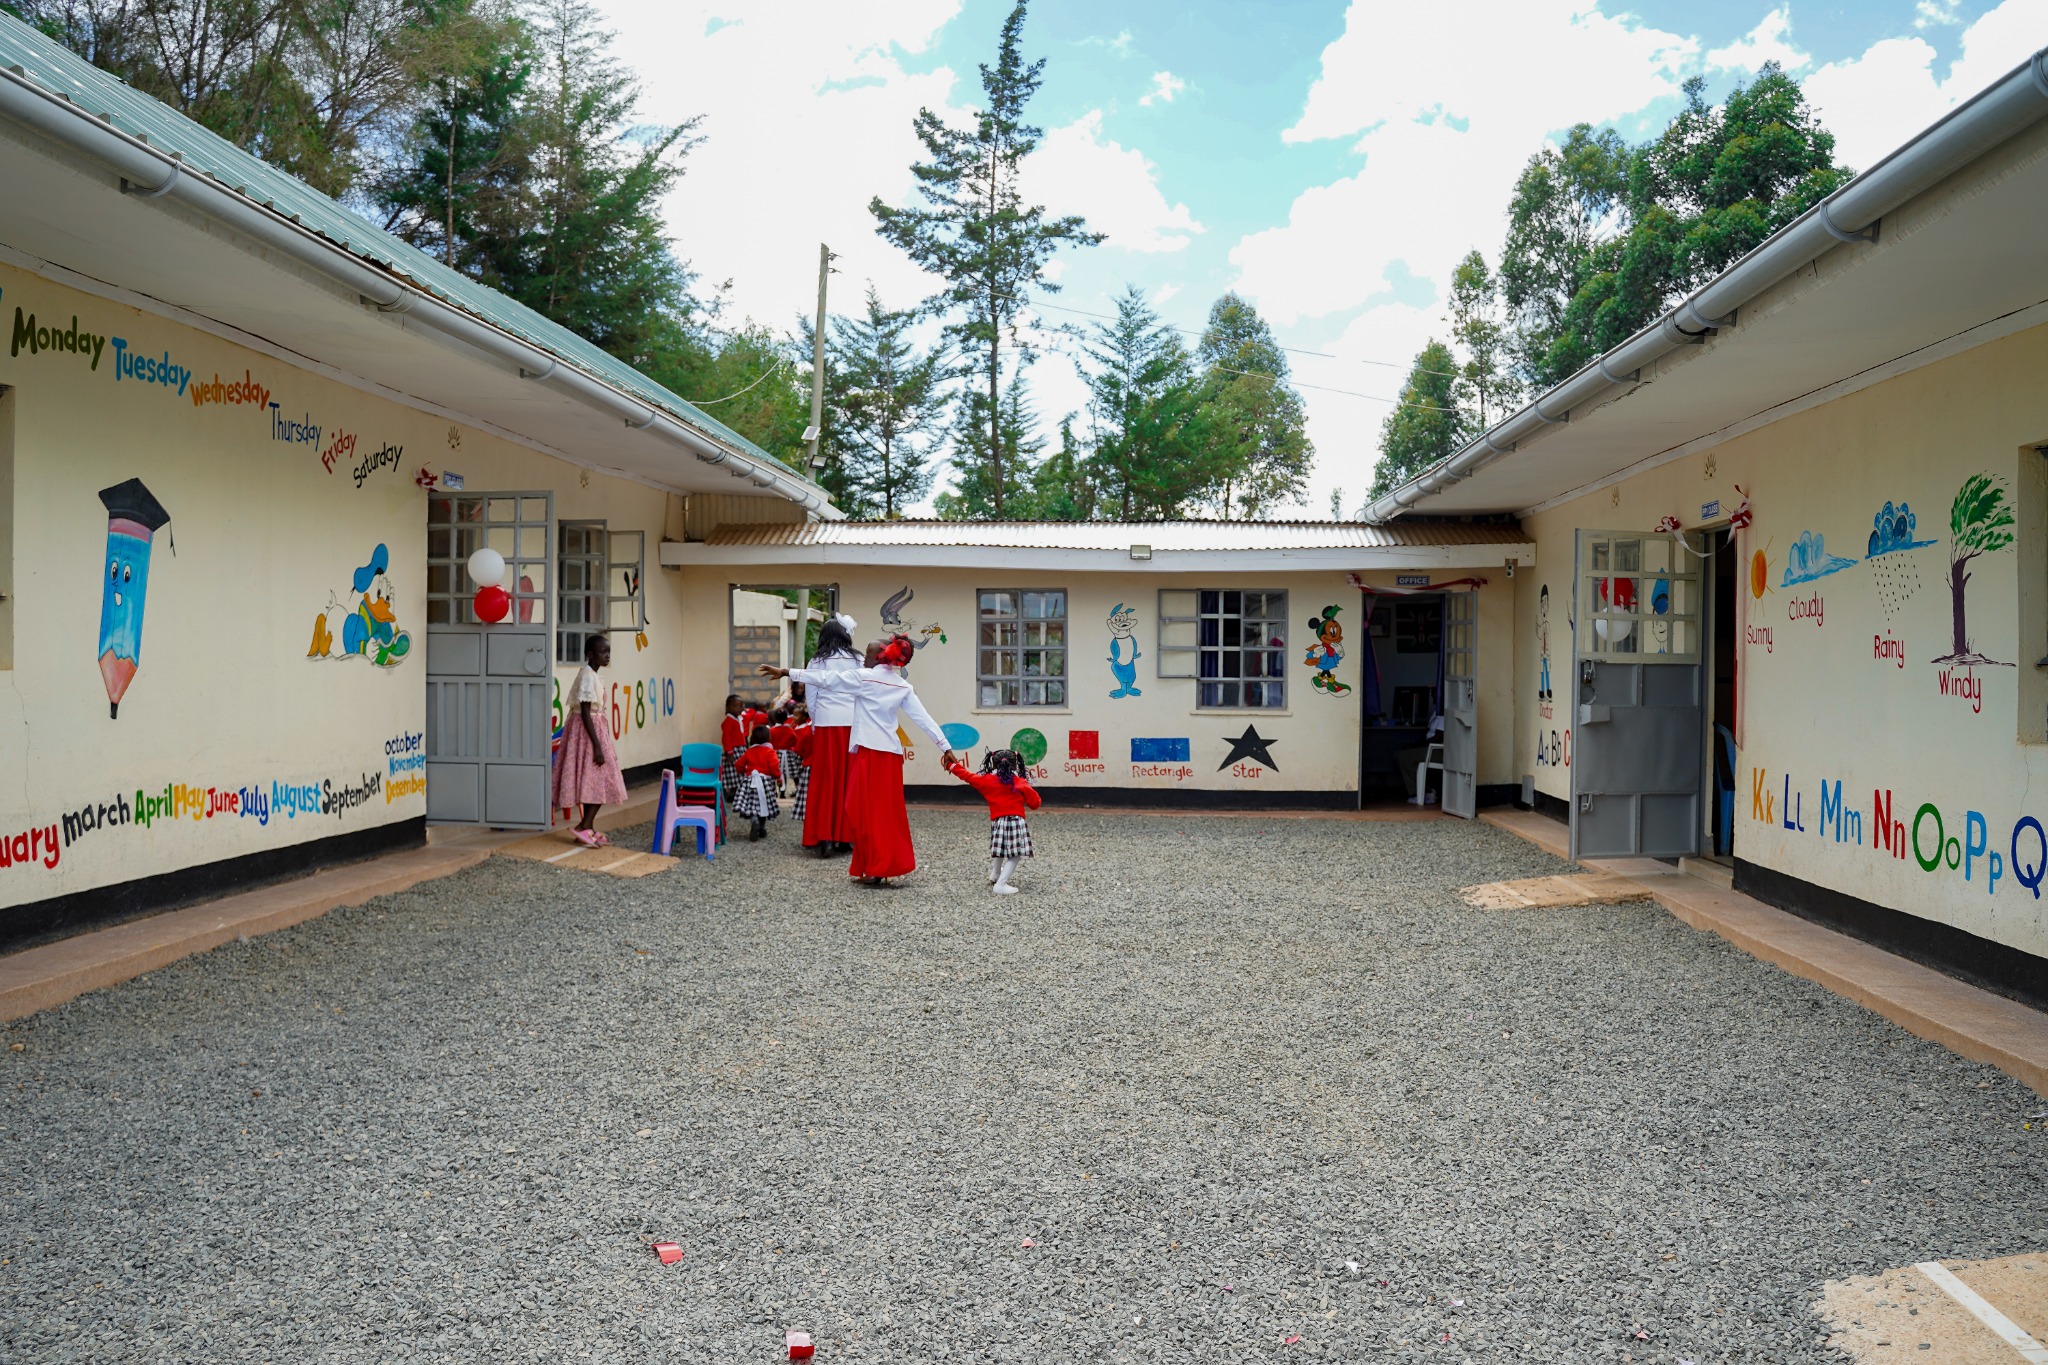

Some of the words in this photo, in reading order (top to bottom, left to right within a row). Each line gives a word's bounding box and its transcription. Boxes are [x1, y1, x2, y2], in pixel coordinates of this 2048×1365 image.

[11, 306, 106, 371] Monday
[111, 336, 192, 397] Tuesday
[268, 401, 322, 453] Thursday
[321, 428, 357, 475] Friday
[1398, 577, 1428, 585] OFFICE
[1747, 624, 1773, 654] Sunny
[1873, 628, 1905, 669] Rainy
[611, 682, 621, 741] 6
[623, 685, 632, 735] 7
[635, 679, 645, 730] 8
[648, 676, 657, 724] 9
[662, 676, 675, 717] 10
[1938, 665, 1982, 714] Windy
[388, 752, 426, 777] November
[1552, 729, 1562, 767] Bb
[1563, 729, 1571, 767] C
[385, 772, 426, 805] December
[1132, 764, 1194, 781] Rectangle
[1232, 762, 1263, 779] Star
[134, 782, 173, 829] April
[173, 783, 207, 822] May
[205, 787, 240, 819] June
[238, 784, 269, 826] July
[271, 779, 322, 819] August
[322, 770, 382, 820] September
[1752, 767, 1775, 825] Kk
[1819, 778, 1862, 846] Mm
[1873, 788, 1906, 860] Nn
[1912, 802, 1961, 873] Oo
[1964, 810, 2003, 895] Pp
[2010, 815, 2047, 900] Q
